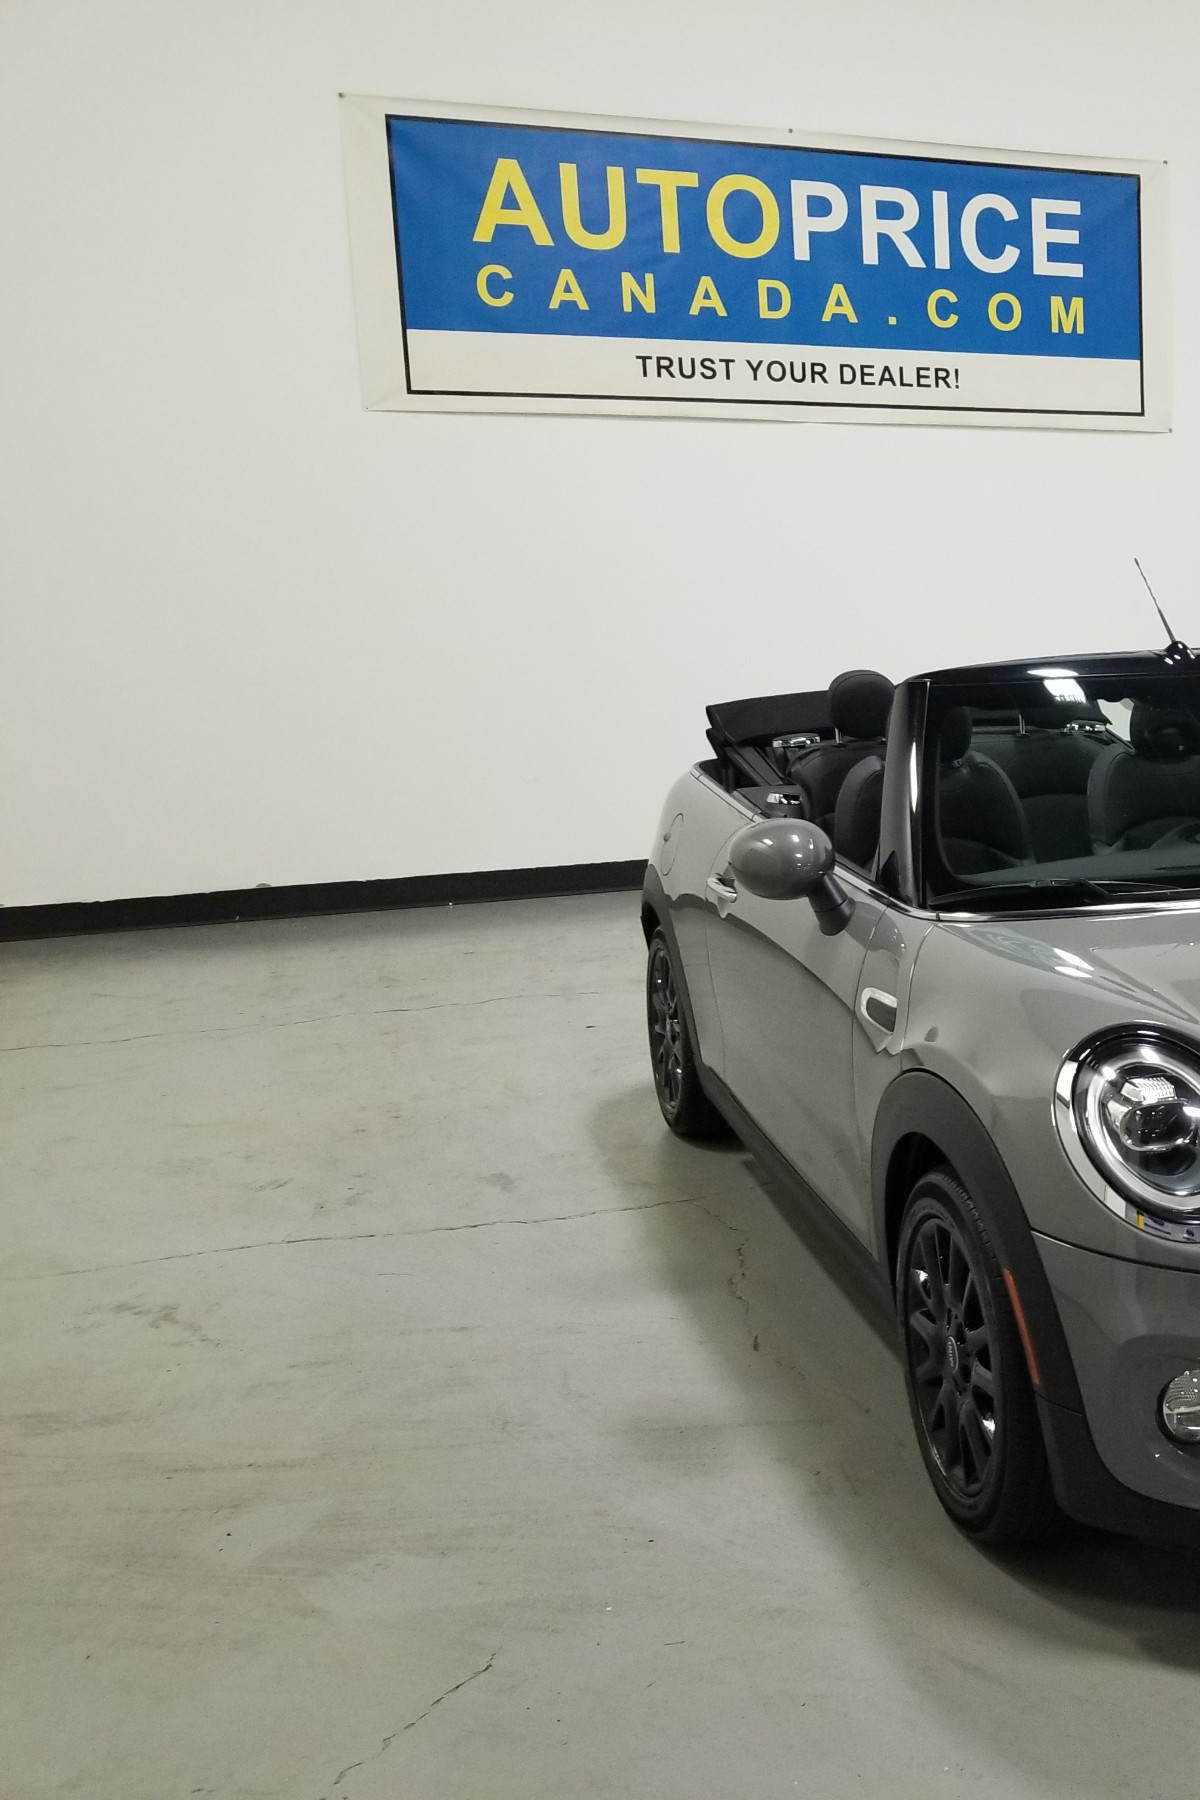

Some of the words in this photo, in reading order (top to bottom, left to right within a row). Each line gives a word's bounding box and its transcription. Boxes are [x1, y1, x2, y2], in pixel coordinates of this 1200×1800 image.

[472, 157, 1085, 279] AUTOPRICE
[476, 264, 1085, 335] CANADA.COM
[635, 354, 737, 382] TRUST
[745, 359, 830, 385] YOUR
[839, 363, 961, 389] DEALER!
